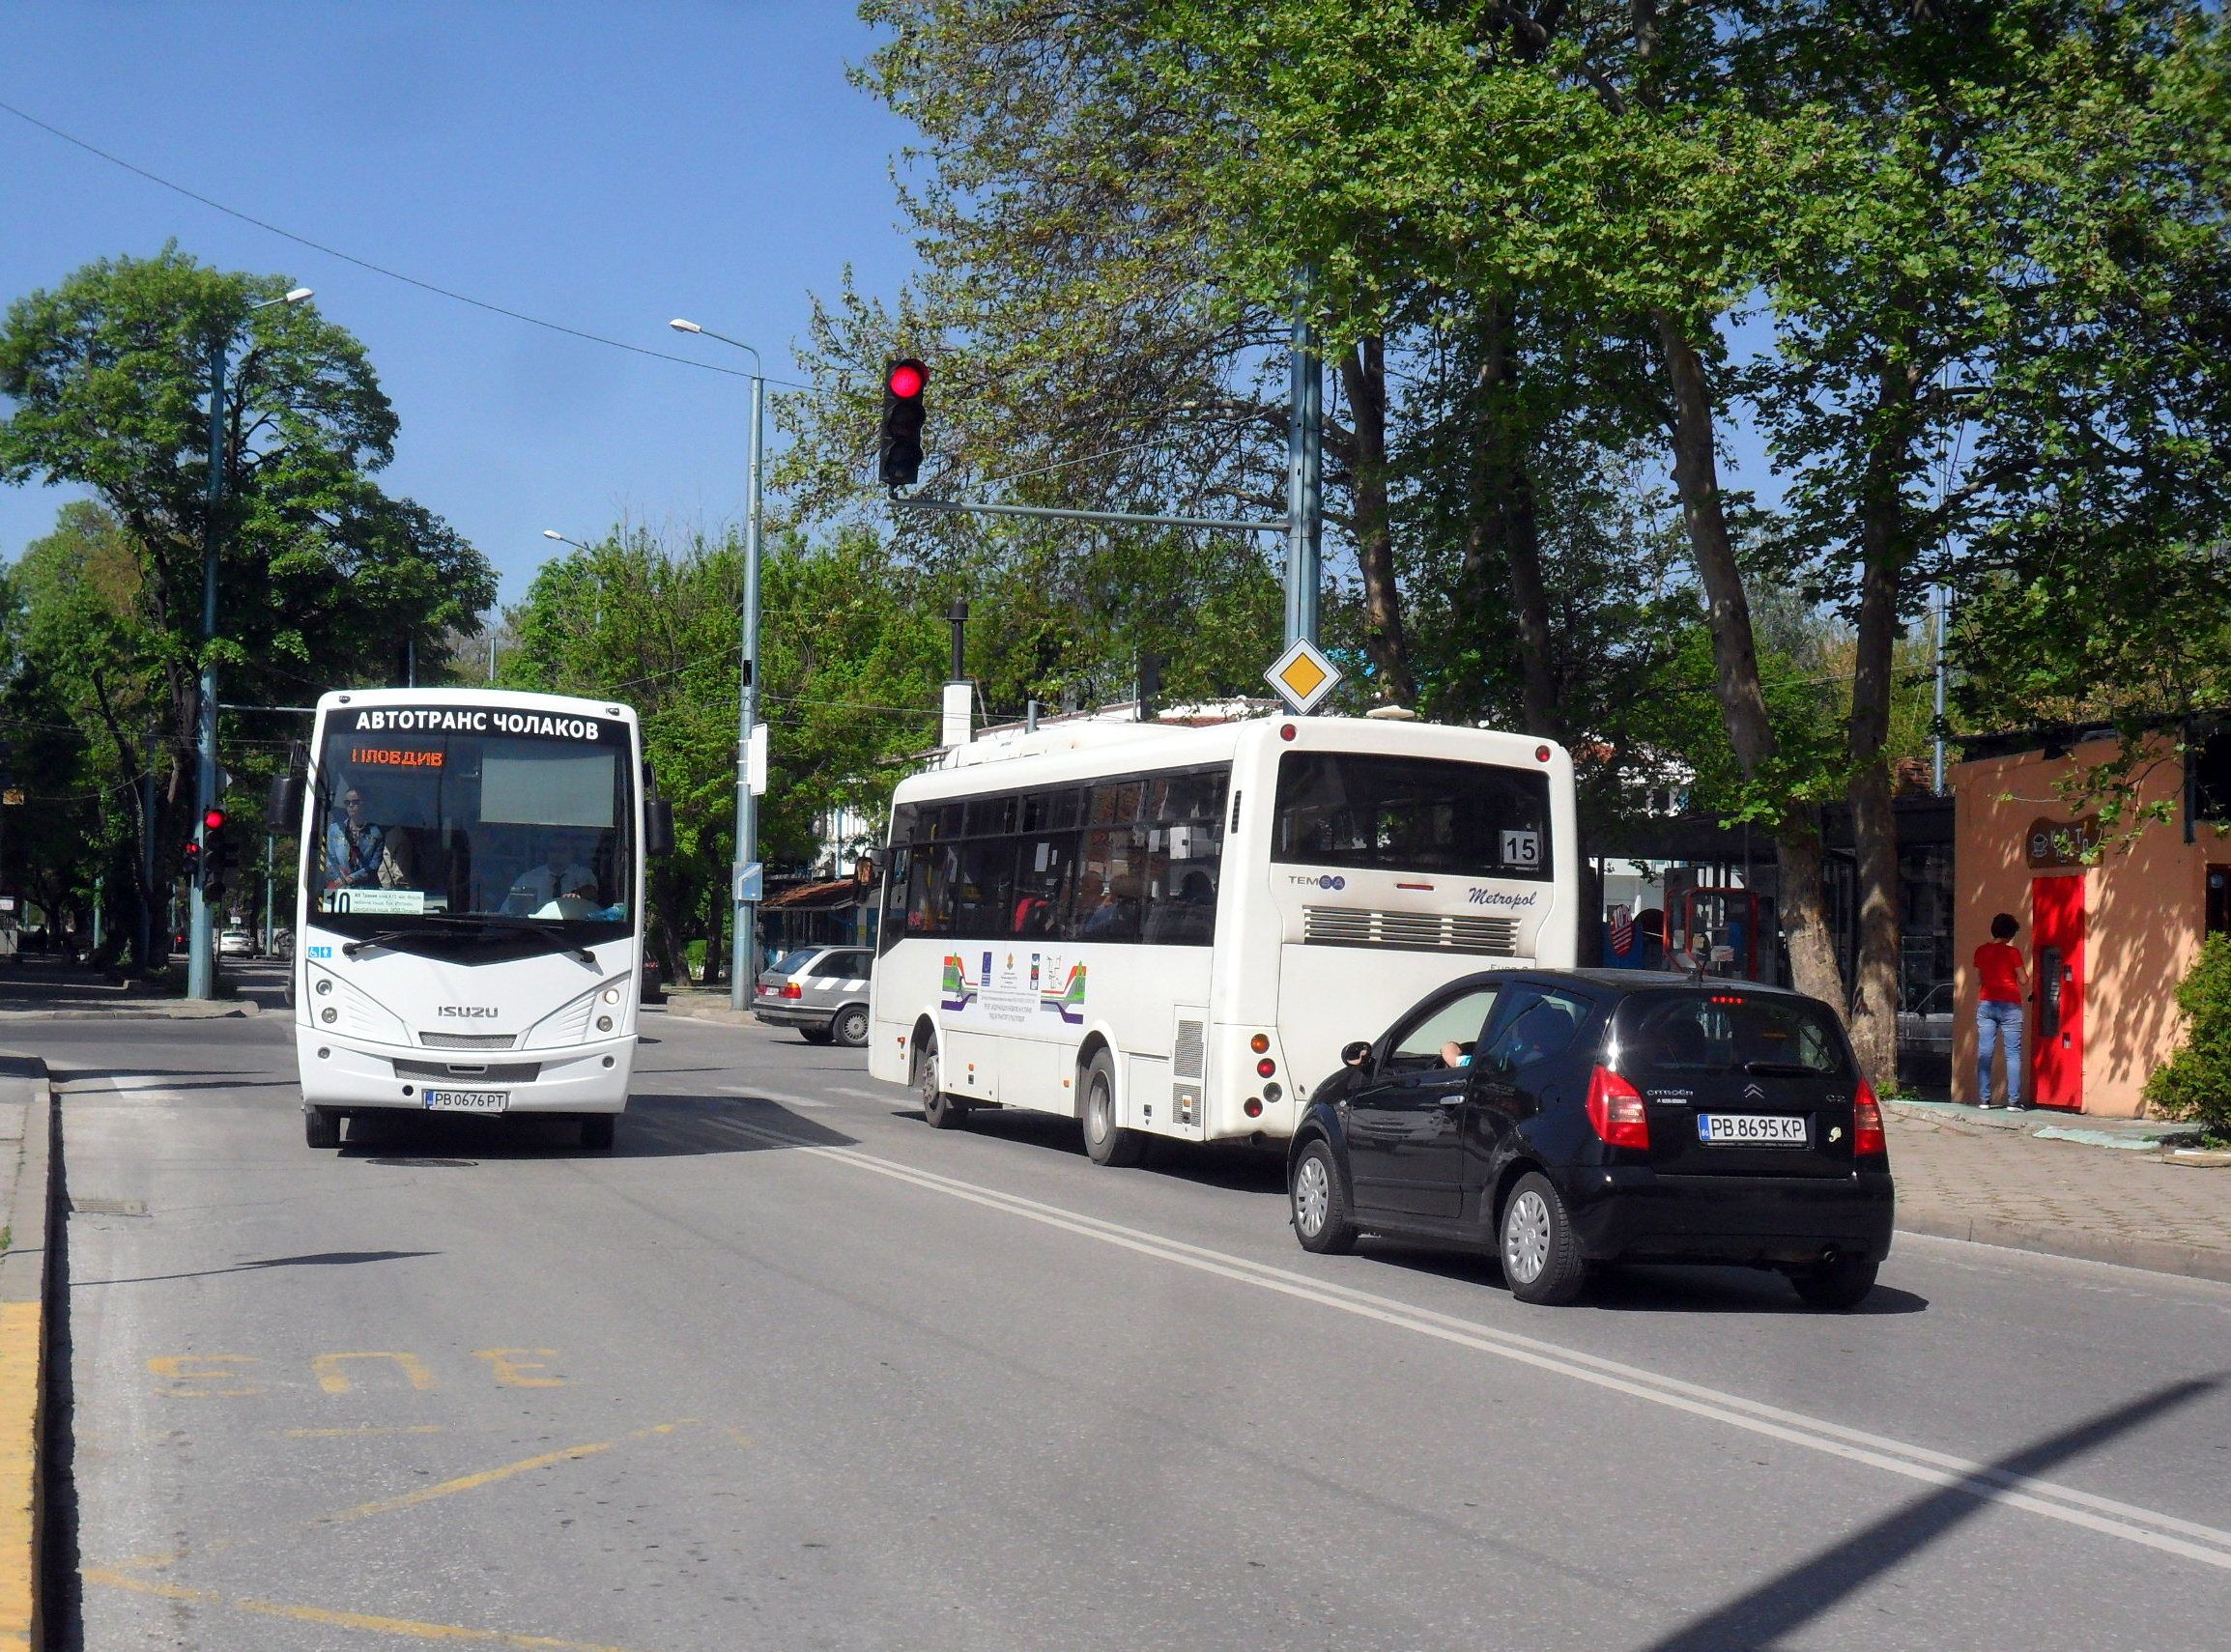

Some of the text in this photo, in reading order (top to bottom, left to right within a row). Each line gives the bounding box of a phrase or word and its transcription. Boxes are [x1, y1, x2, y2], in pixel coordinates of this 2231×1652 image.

[356, 711, 599, 740] АВТОТРАНС ЧОЛАКОВ
[1506, 837, 1536, 861] 15
[327, 892, 351, 915] 10
[1469, 887, 1537, 910] Metropol
[438, 1006, 499, 1018] ISUZU
[435, 1093, 503, 1107] PB 0676 PT
[1711, 1118, 1734, 1137] PB
[1738, 1119, 1779, 1137] 8695
[1782, 1120, 1803, 1138] KP
